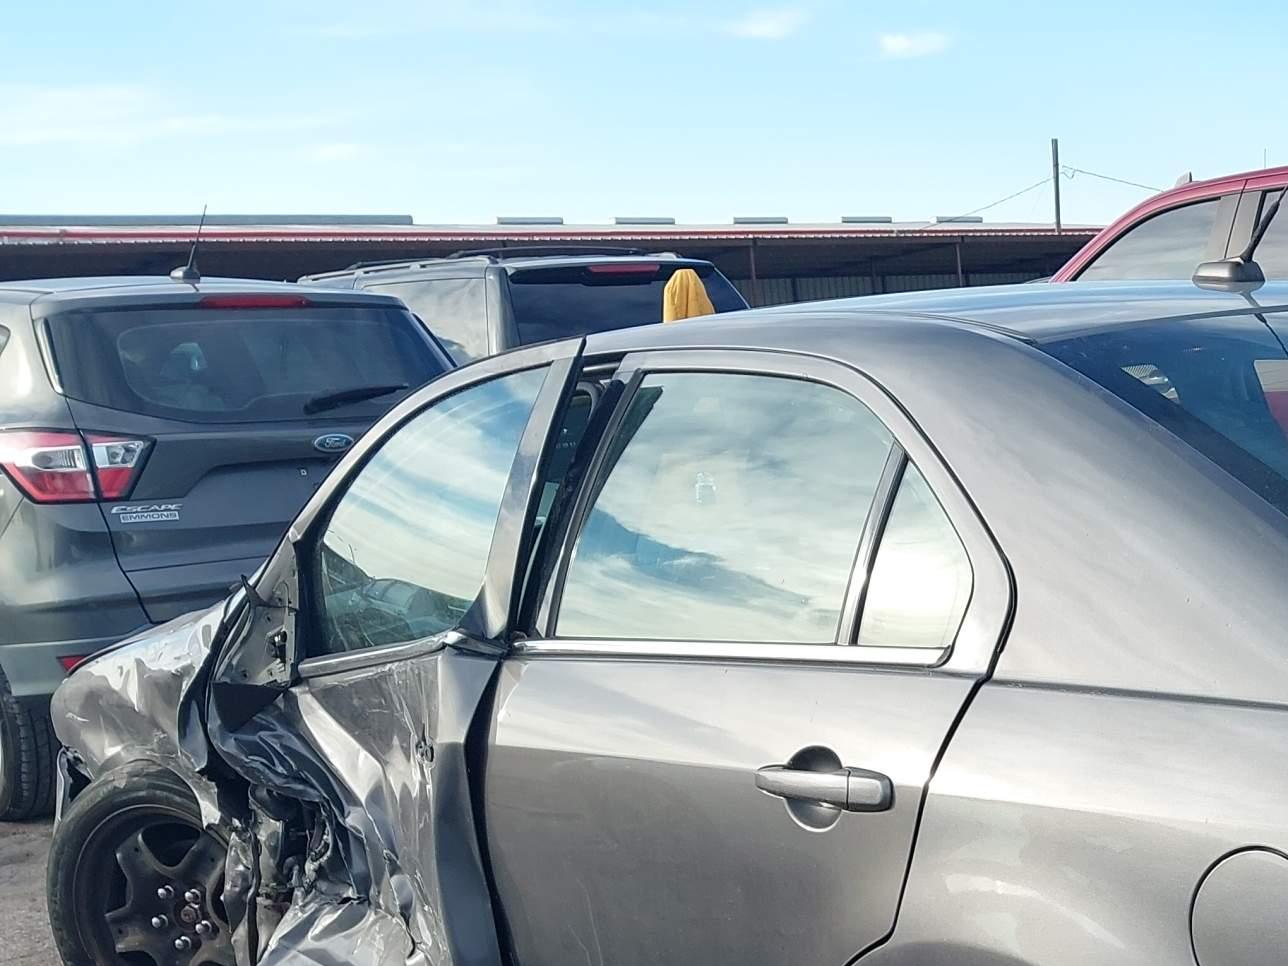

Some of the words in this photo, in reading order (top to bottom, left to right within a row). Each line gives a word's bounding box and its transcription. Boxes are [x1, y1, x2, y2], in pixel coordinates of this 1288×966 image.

[324, 437, 347, 449] Ford
[111, 503, 184, 514] ESCAPE
[121, 512, 179, 522] EMMONS
